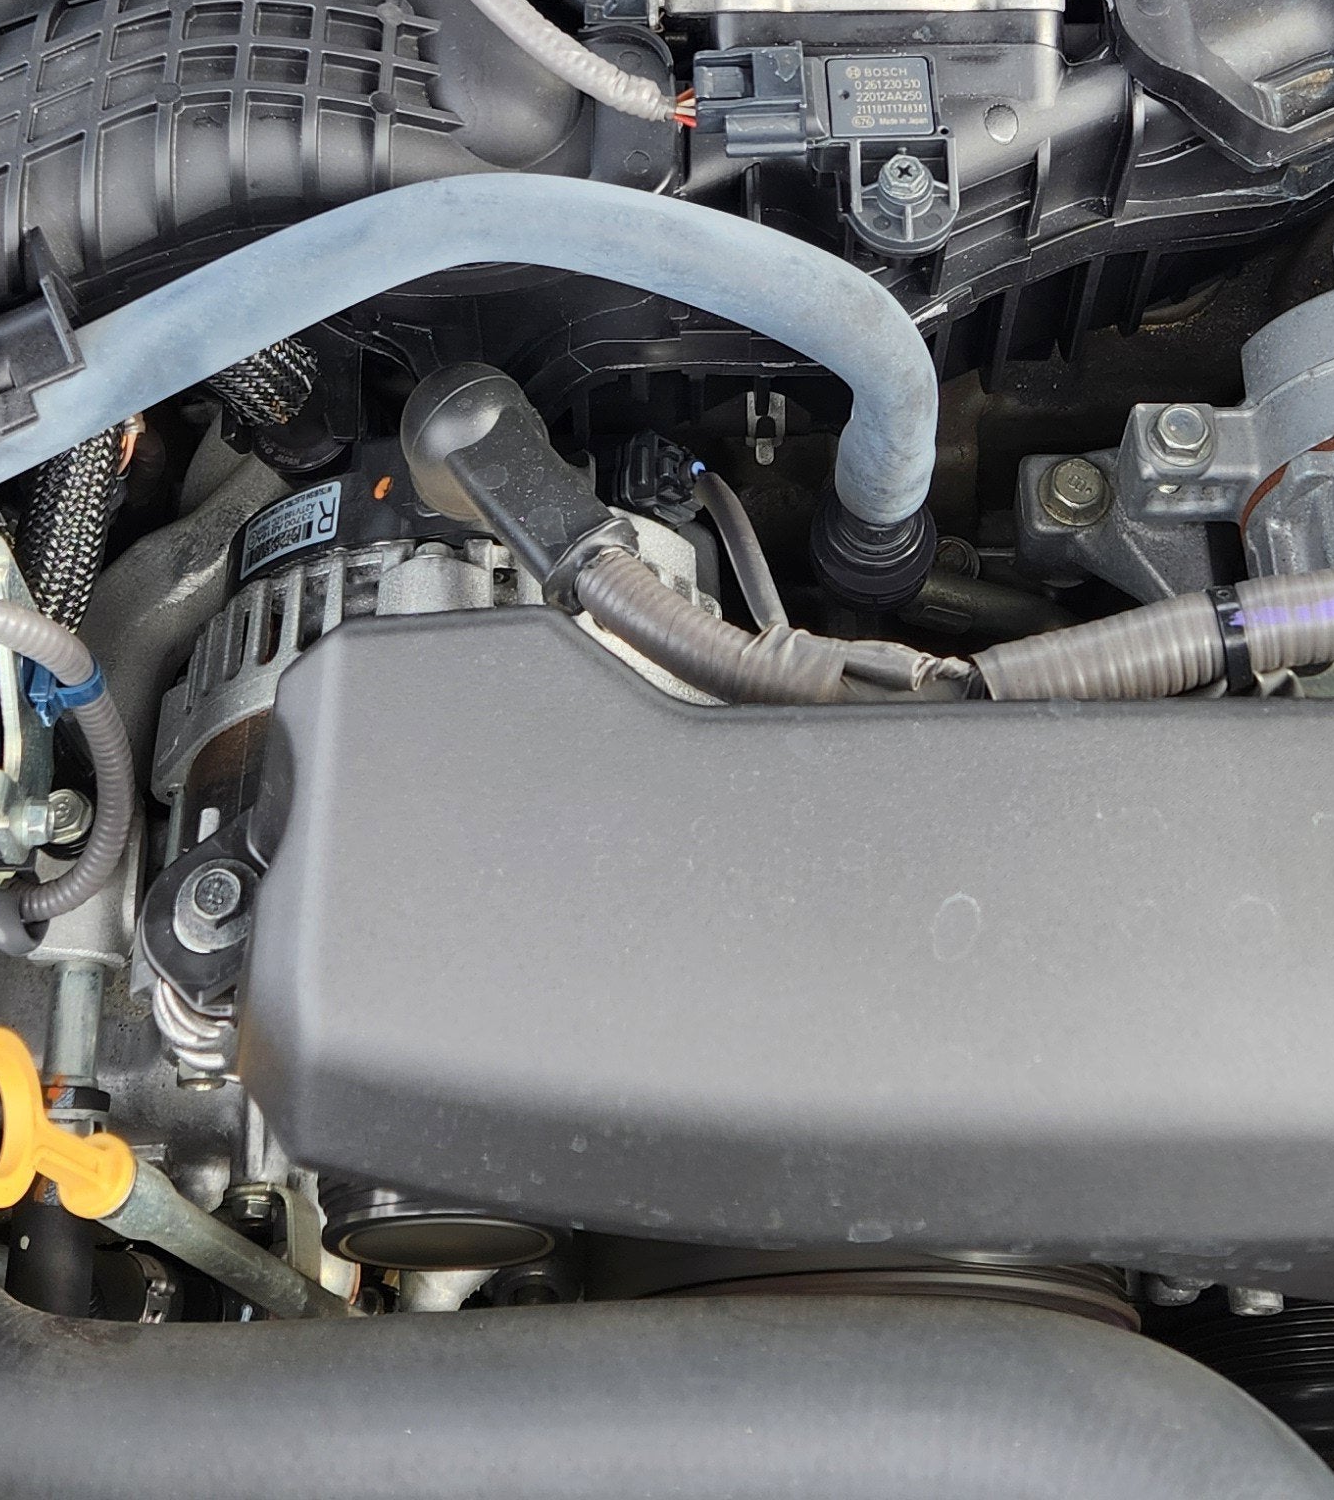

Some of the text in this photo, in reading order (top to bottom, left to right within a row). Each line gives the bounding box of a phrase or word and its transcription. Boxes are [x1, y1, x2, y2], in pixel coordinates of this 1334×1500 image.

[864, 67, 907, 77] BOSCH
[855, 79, 921, 90] 0 261 230 510
[856, 91, 922, 102] 22012AA250
[879, 117, 899, 125] Made
[908, 116, 928, 126] Japan
[317, 497, 337, 533] R
